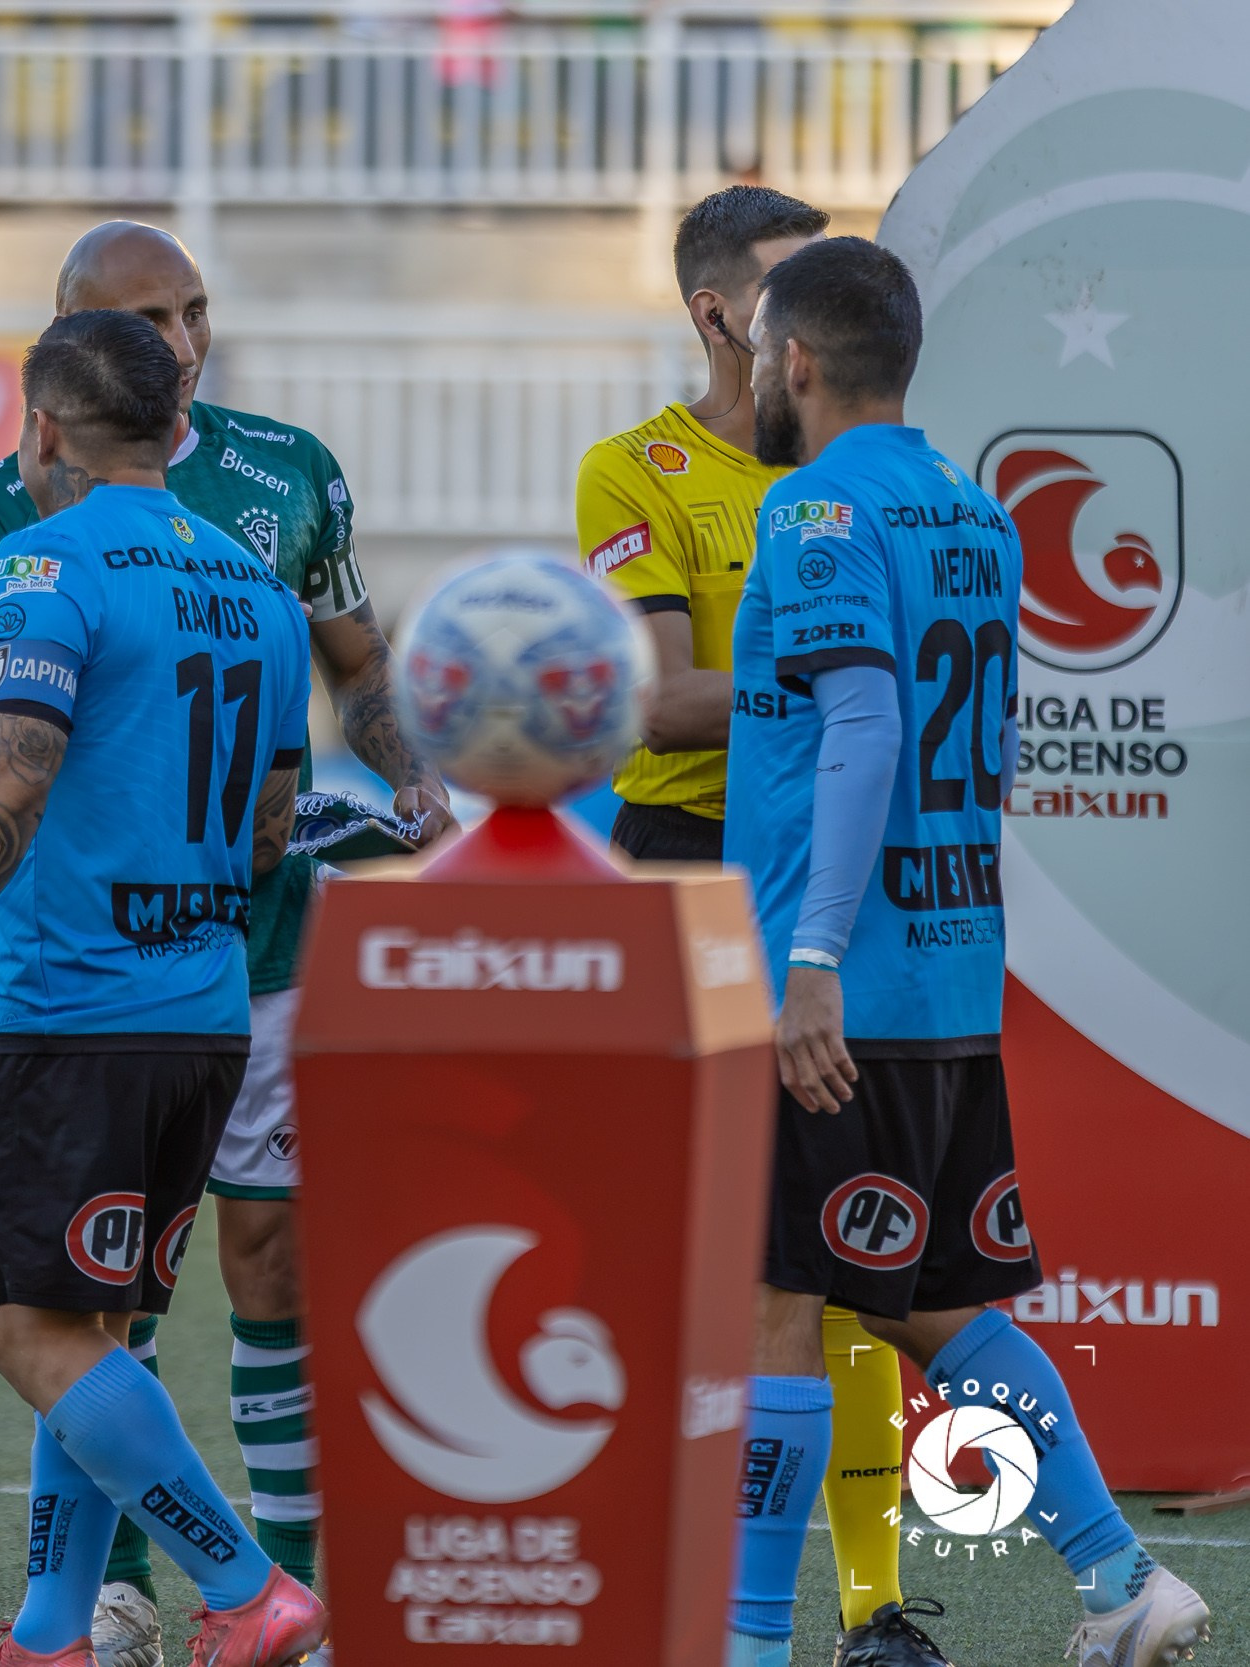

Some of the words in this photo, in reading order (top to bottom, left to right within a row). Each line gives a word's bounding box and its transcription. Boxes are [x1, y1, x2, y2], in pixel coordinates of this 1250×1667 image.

[220, 447, 289, 497] Biozen
[8, 582, 27, 590] para
[30, 580, 53, 588] todos
[930, 547, 1002, 598] MEDNA
[172, 587, 259, 641] RAMOS
[793, 623, 866, 646] ZOFRI
[916, 619, 1011, 814] 20
[1110, 697, 1166, 732] DE
[176, 652, 262, 848] 11
[1017, 740, 1188, 778] SCENSO
[1002, 783, 1169, 820] Caixun
[358, 923, 623, 993] Caixun
[843, 1188, 910, 1252] PF
[1012, 1266, 1221, 1328] aixun
[405, 1516, 507, 1563] LIGA
[514, 1517, 581, 1563] DE
[386, 1562, 602, 1606] ASCENSO
[405, 1607, 582, 1647] Caixun
